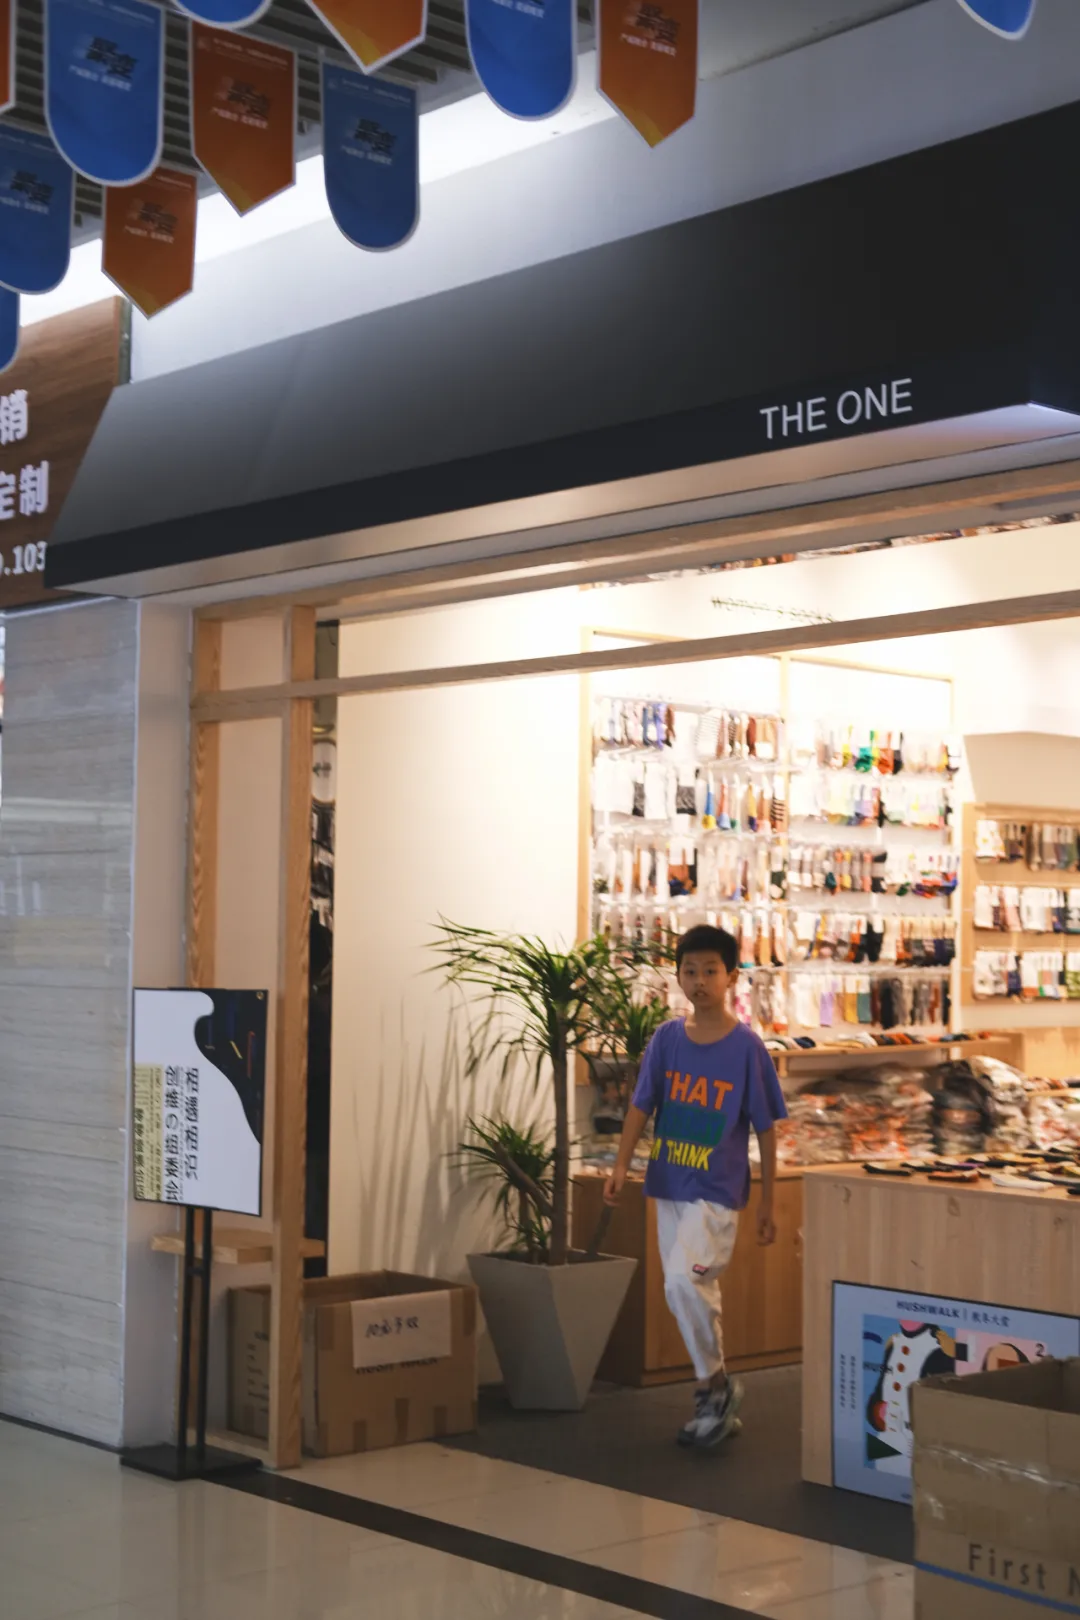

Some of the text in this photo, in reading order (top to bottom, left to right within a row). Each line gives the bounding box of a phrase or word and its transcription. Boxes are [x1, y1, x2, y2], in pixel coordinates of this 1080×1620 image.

[759, 377, 913, 440] THE ONE
[665, 1069, 734, 1111] HAT
[665, 1139, 714, 1171] THINK
[896, 1300, 961, 1319] HUSHWALK
[968, 1543, 1046, 1590] First
